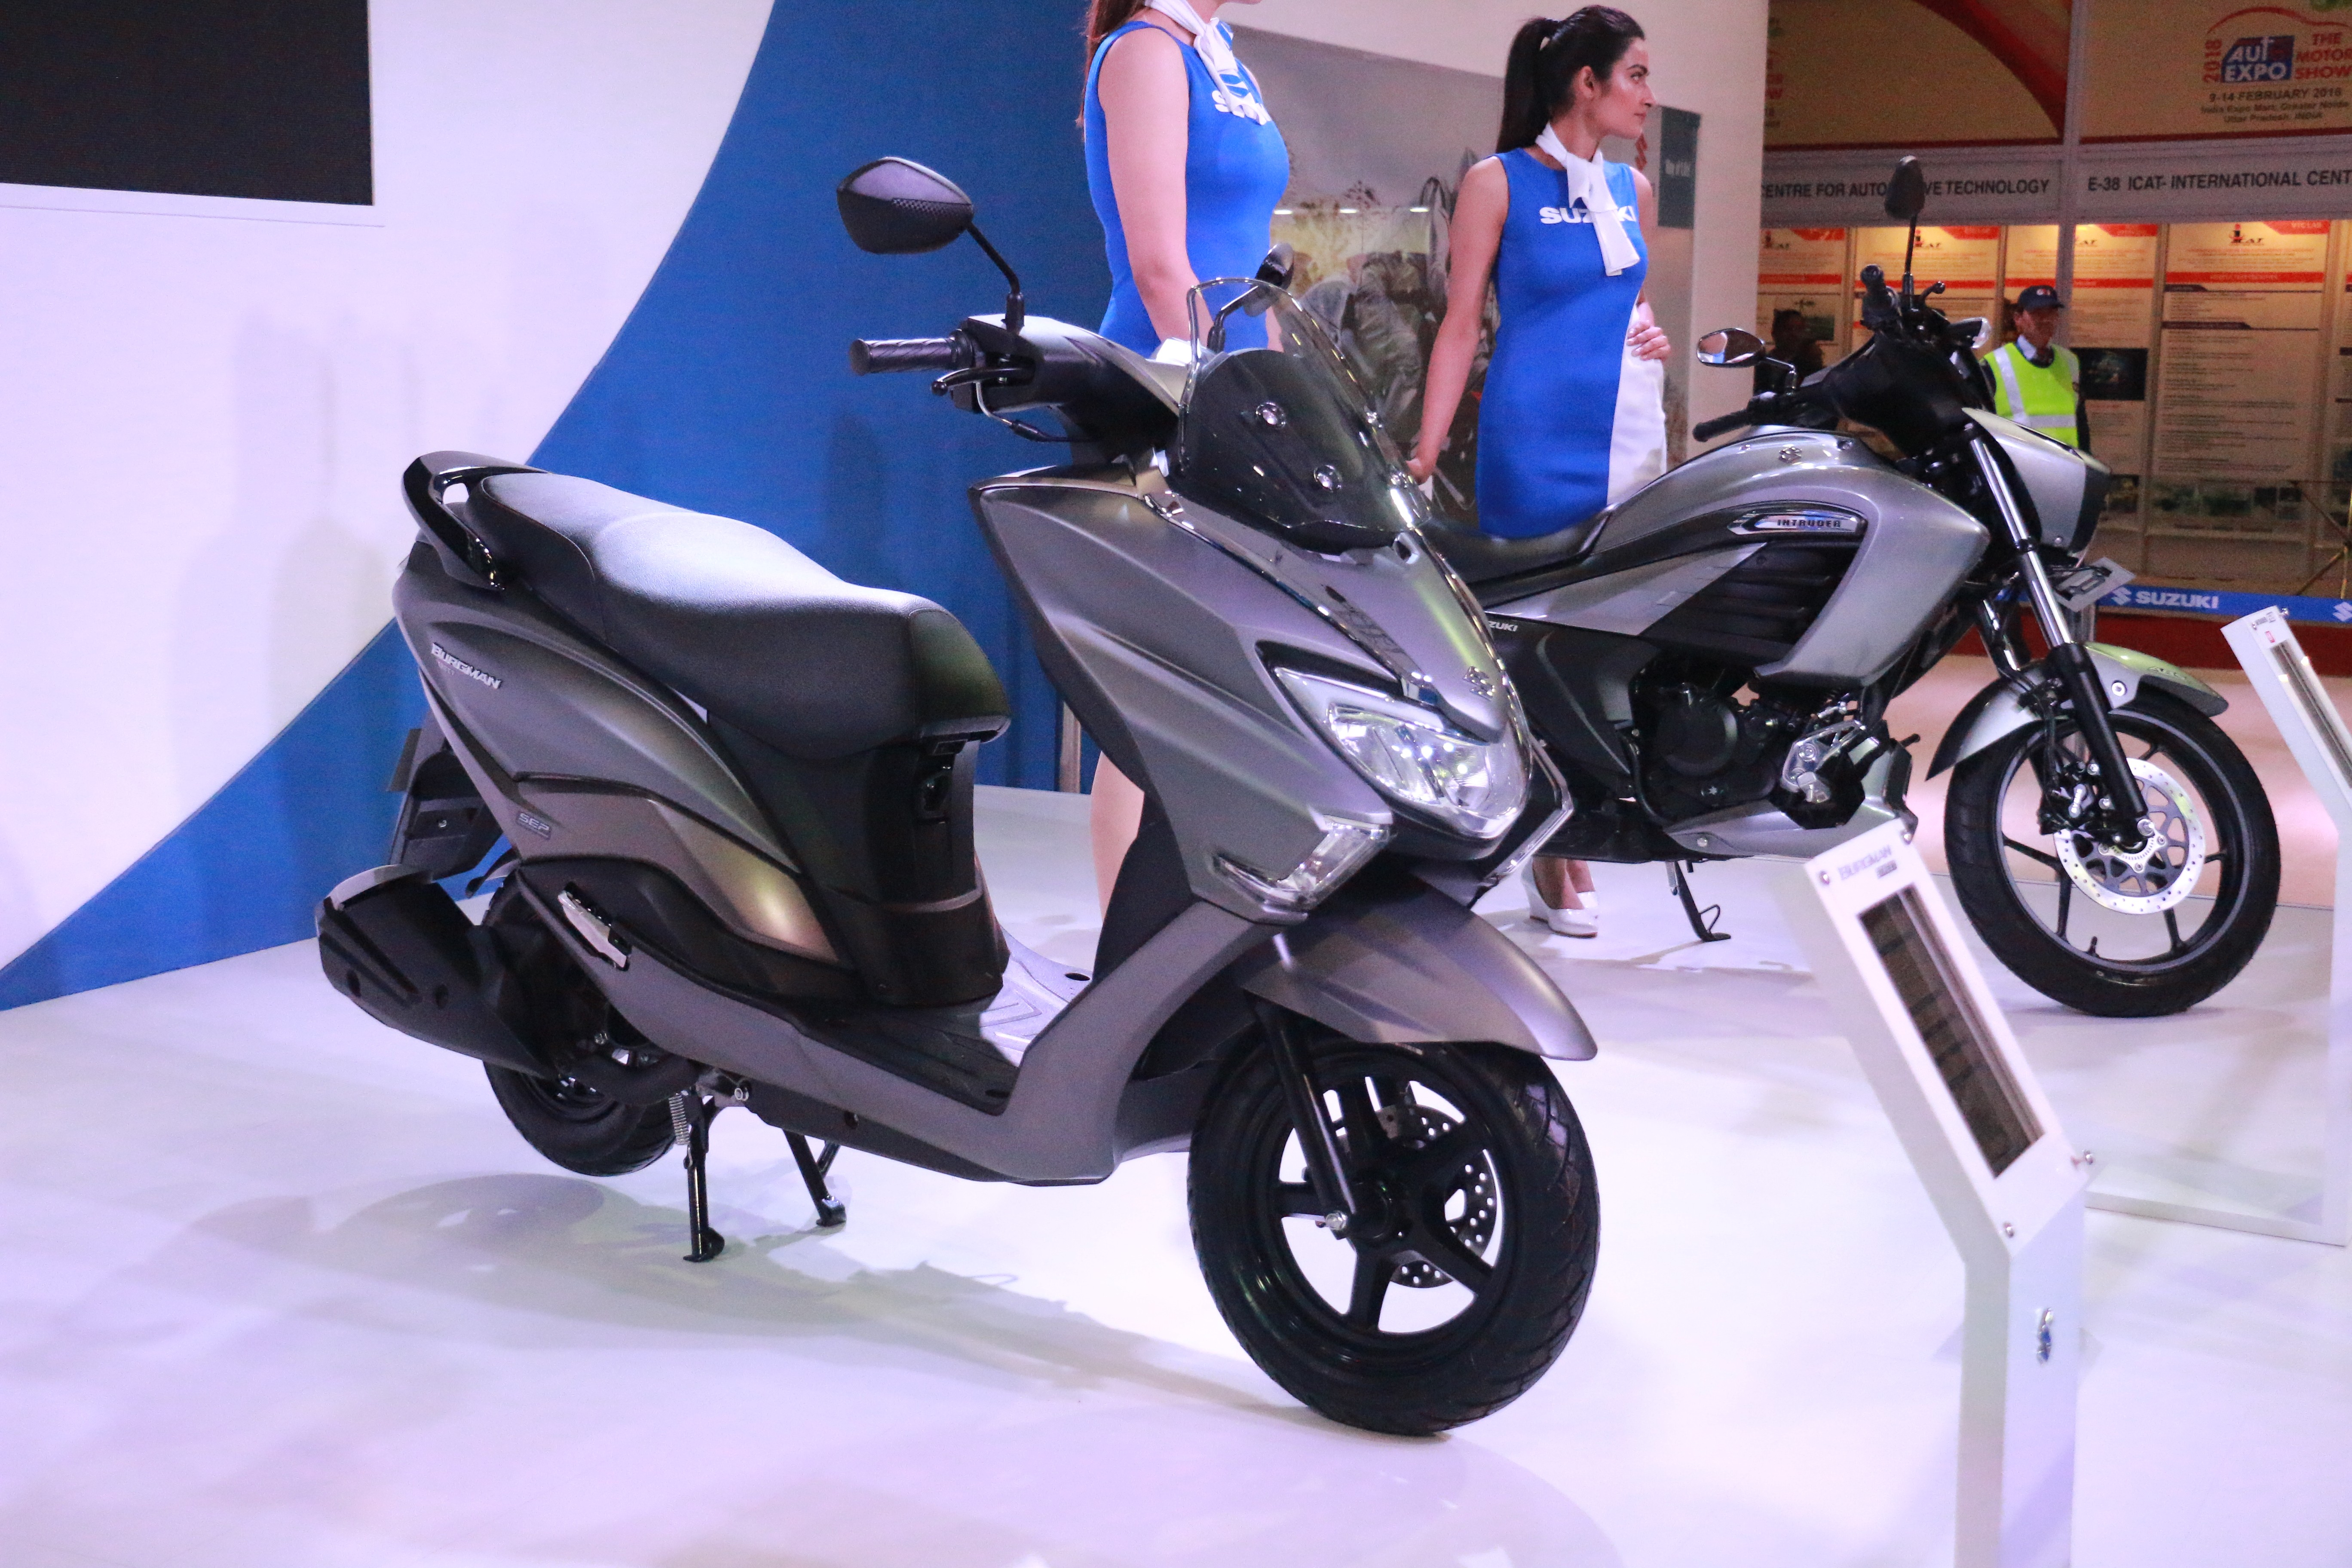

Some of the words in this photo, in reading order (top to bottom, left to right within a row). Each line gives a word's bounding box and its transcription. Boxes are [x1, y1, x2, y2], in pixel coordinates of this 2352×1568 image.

[2312, 31, 2343, 46] THE
[2224, 62, 2288, 82] EXPO
[2295, 65, 2352, 80] SHOW
[2238, 89, 2309, 101] FEBRUARY
[1816, 183, 1846, 197] FOR
[1849, 181, 1942, 197] AUTOVE
[1946, 179, 2050, 195] TECHNOLOGY
[2088, 176, 2121, 191] E-38
[2171, 172, 2301, 190] INTERNATIONAL
[1539, 205, 1636, 224] SUZKI
[1777, 519, 1841, 527] INTRUDER
[2135, 591, 2218, 609] SUZUKI
[1488, 621, 1518, 632] ZUKI
[431, 642, 502, 689] BURGMAN
[518, 812, 549, 831] SEP
